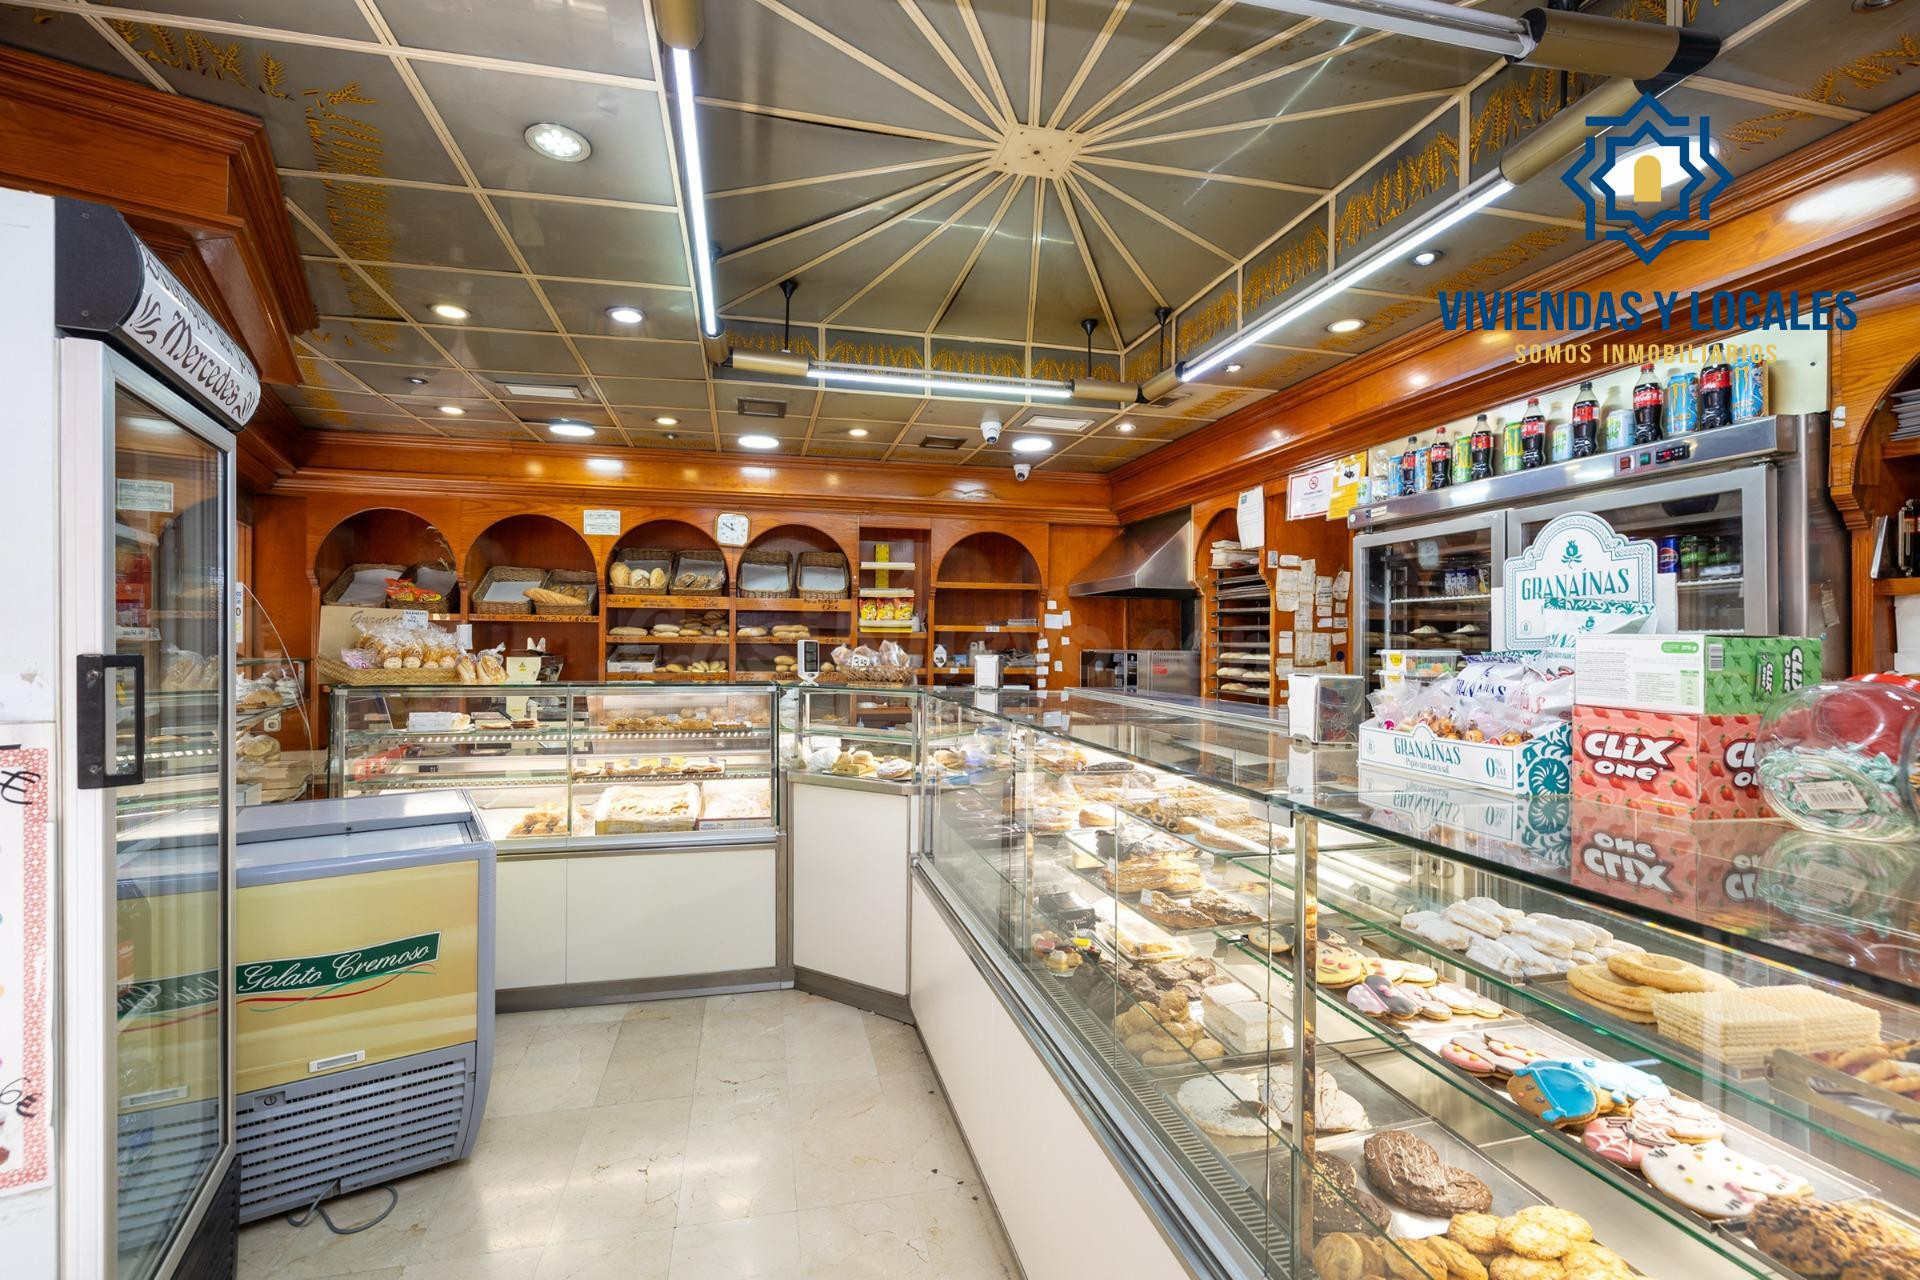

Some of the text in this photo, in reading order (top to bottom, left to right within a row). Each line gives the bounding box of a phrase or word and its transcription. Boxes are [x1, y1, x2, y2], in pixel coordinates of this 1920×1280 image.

[160, 310, 241, 405] Mercedes
[1521, 567, 1630, 601] GRANAÍNAS
[1726, 742, 1756, 768] CL
[238, 944, 429, 992] Gelato Cremoso
